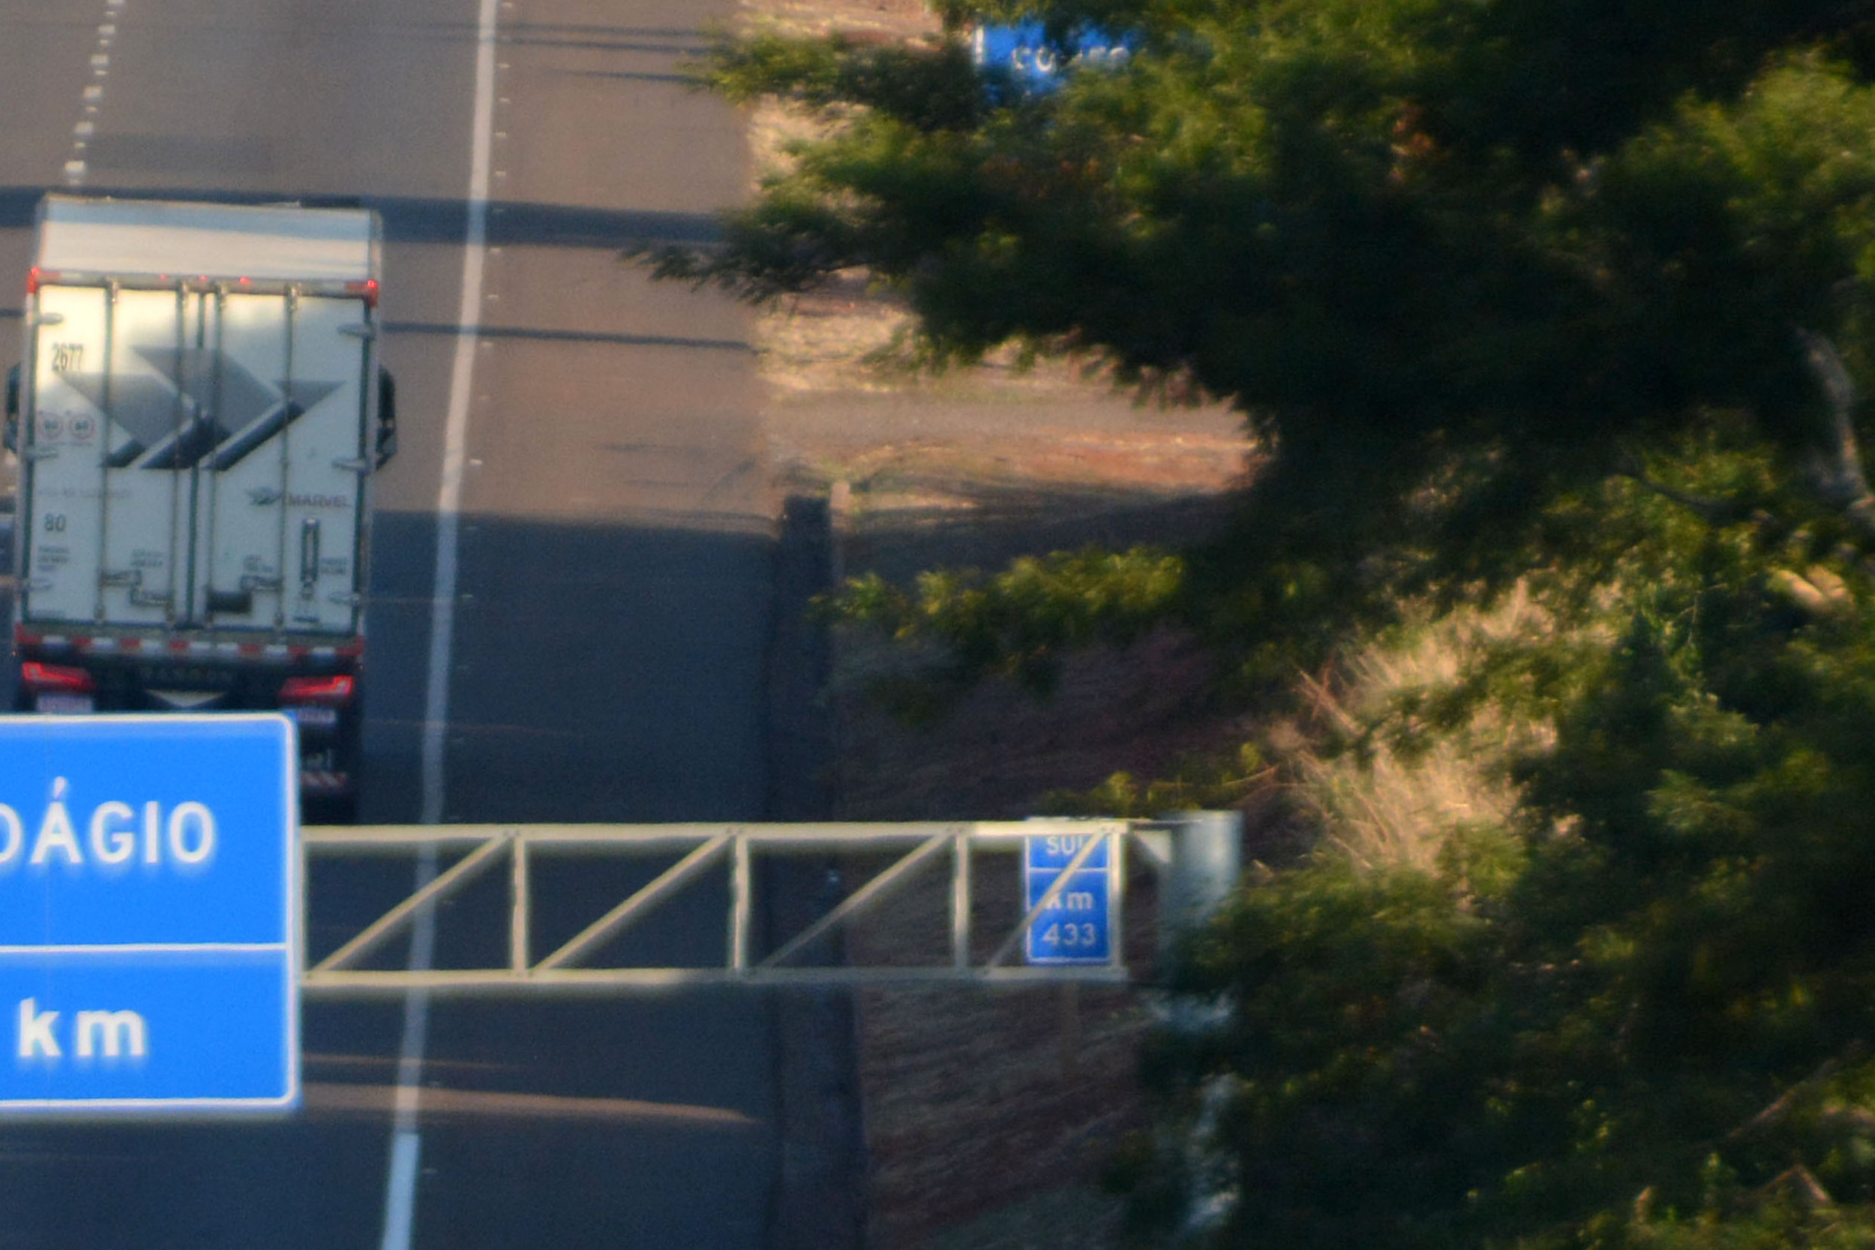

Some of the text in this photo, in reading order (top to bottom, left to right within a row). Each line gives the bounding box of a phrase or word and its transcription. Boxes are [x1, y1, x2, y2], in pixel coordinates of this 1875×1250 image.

[43, 513, 67, 533] 80
[1042, 922, 1096, 947] 433
[19, 996, 147, 1058] km
